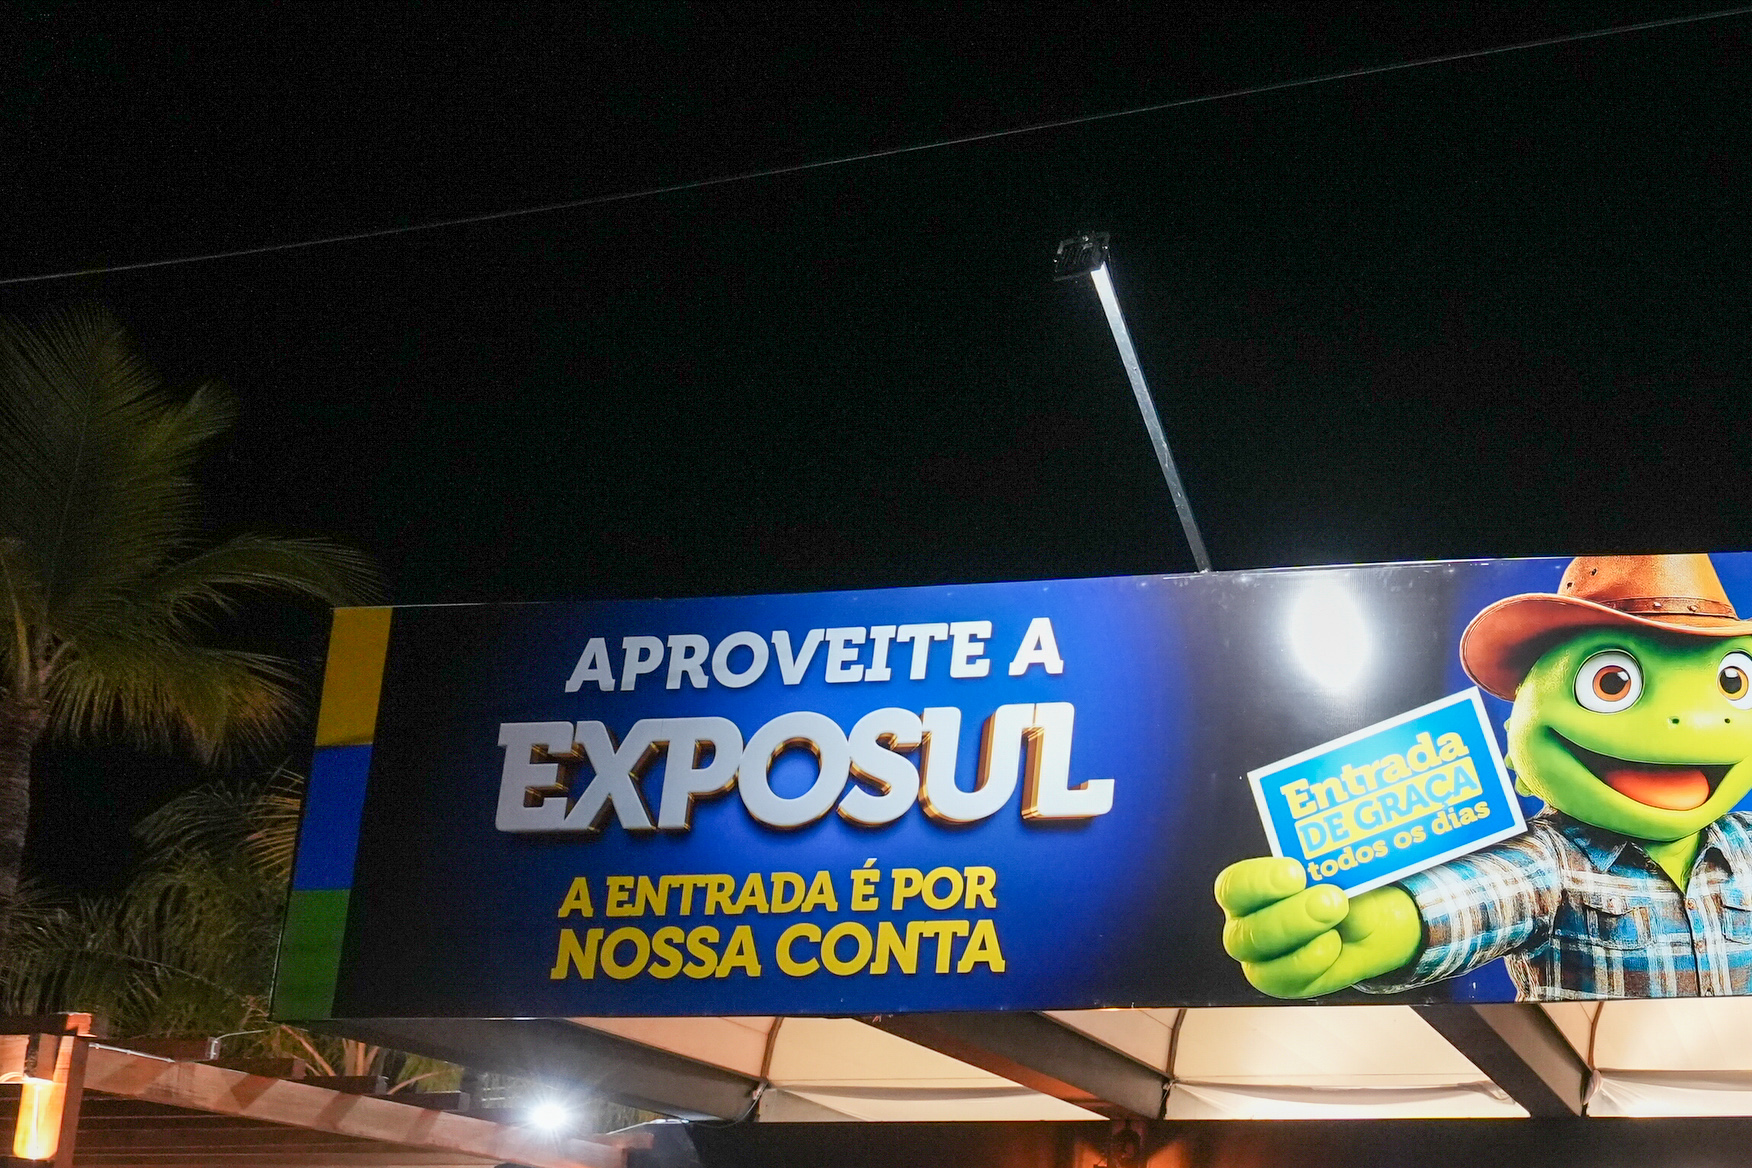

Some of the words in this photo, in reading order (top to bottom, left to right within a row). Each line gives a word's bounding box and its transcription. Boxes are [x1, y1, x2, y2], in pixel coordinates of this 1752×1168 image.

[565, 619, 993, 693] APROVEITE
[1008, 617, 1065, 676] A
[495, 701, 1117, 834] EXPOSUL
[1280, 731, 1470, 819] Entrada
[1299, 811, 1350, 852] DE
[1353, 764, 1479, 831] GRAÇA
[1307, 838, 1388, 881] todos
[1393, 824, 1427, 849] os
[1431, 801, 1491, 835] dias
[558, 877, 595, 918] A
[605, 869, 840, 918] ENTRADA
[850, 857, 881, 912] É
[892, 864, 998, 911] POR
[550, 924, 762, 982] NOSSA
[774, 918, 1007, 976] CONTA
